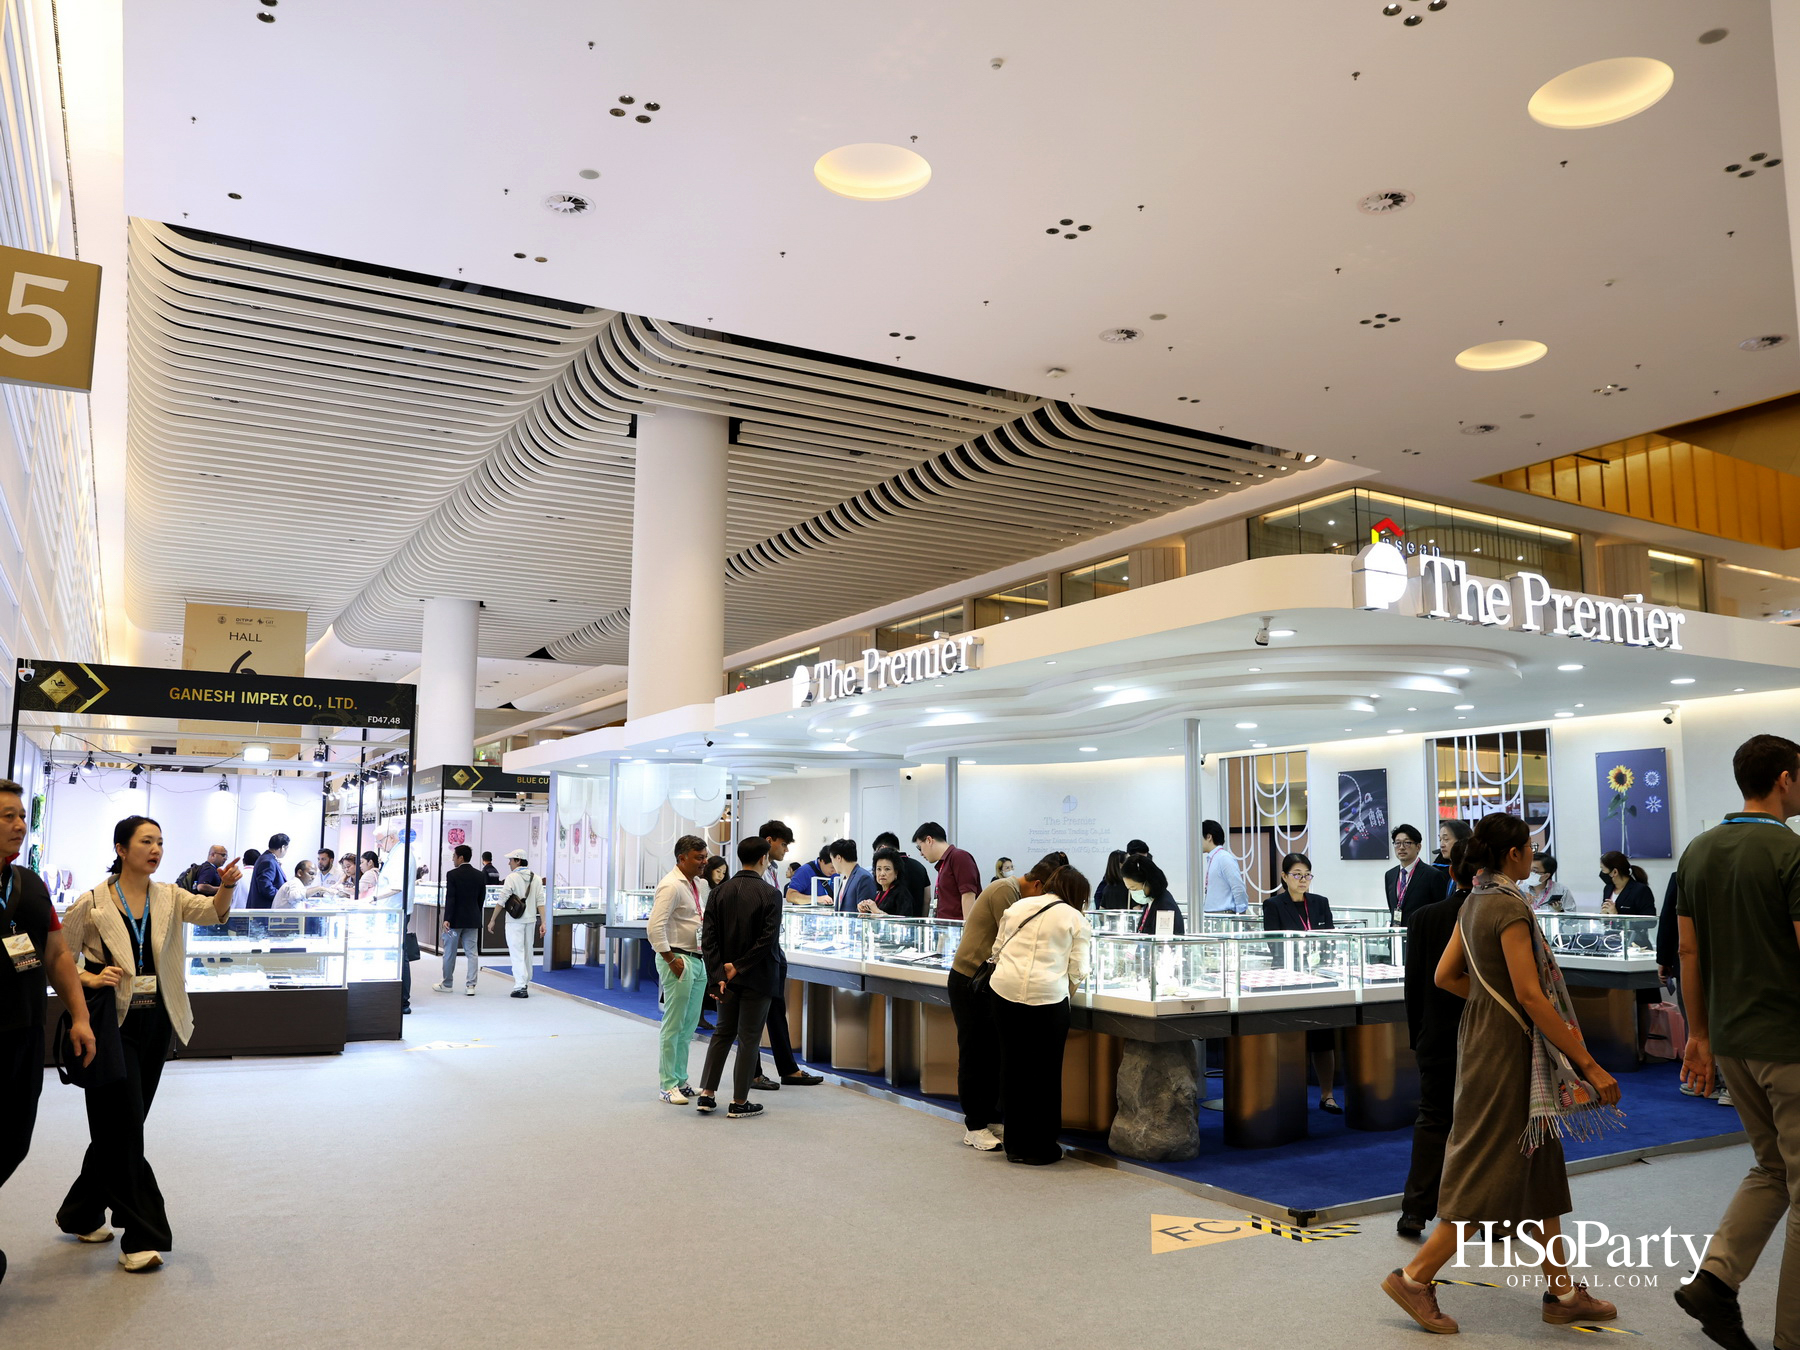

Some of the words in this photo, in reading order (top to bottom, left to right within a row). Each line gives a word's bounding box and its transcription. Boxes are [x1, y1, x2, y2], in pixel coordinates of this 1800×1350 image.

[0, 271, 70, 358] 5
[1419, 554, 1511, 626] The
[1517, 571, 1686, 651] Premier
[229, 631, 262, 643] HALL
[814, 658, 857, 703] The
[862, 631, 974, 693] Premier
[169, 687, 235, 703] GANESH
[241, 691, 289, 706] IMPEX
[292, 694, 322, 711] CO.,
[328, 696, 358, 710] LTD.
[367, 715, 401, 725] FD47,48
[517, 776, 537, 784] BLUE
[1043, 816, 1061, 826] The
[1062, 816, 1097, 826] Premier
[1155, 1220, 1242, 1242] FC
